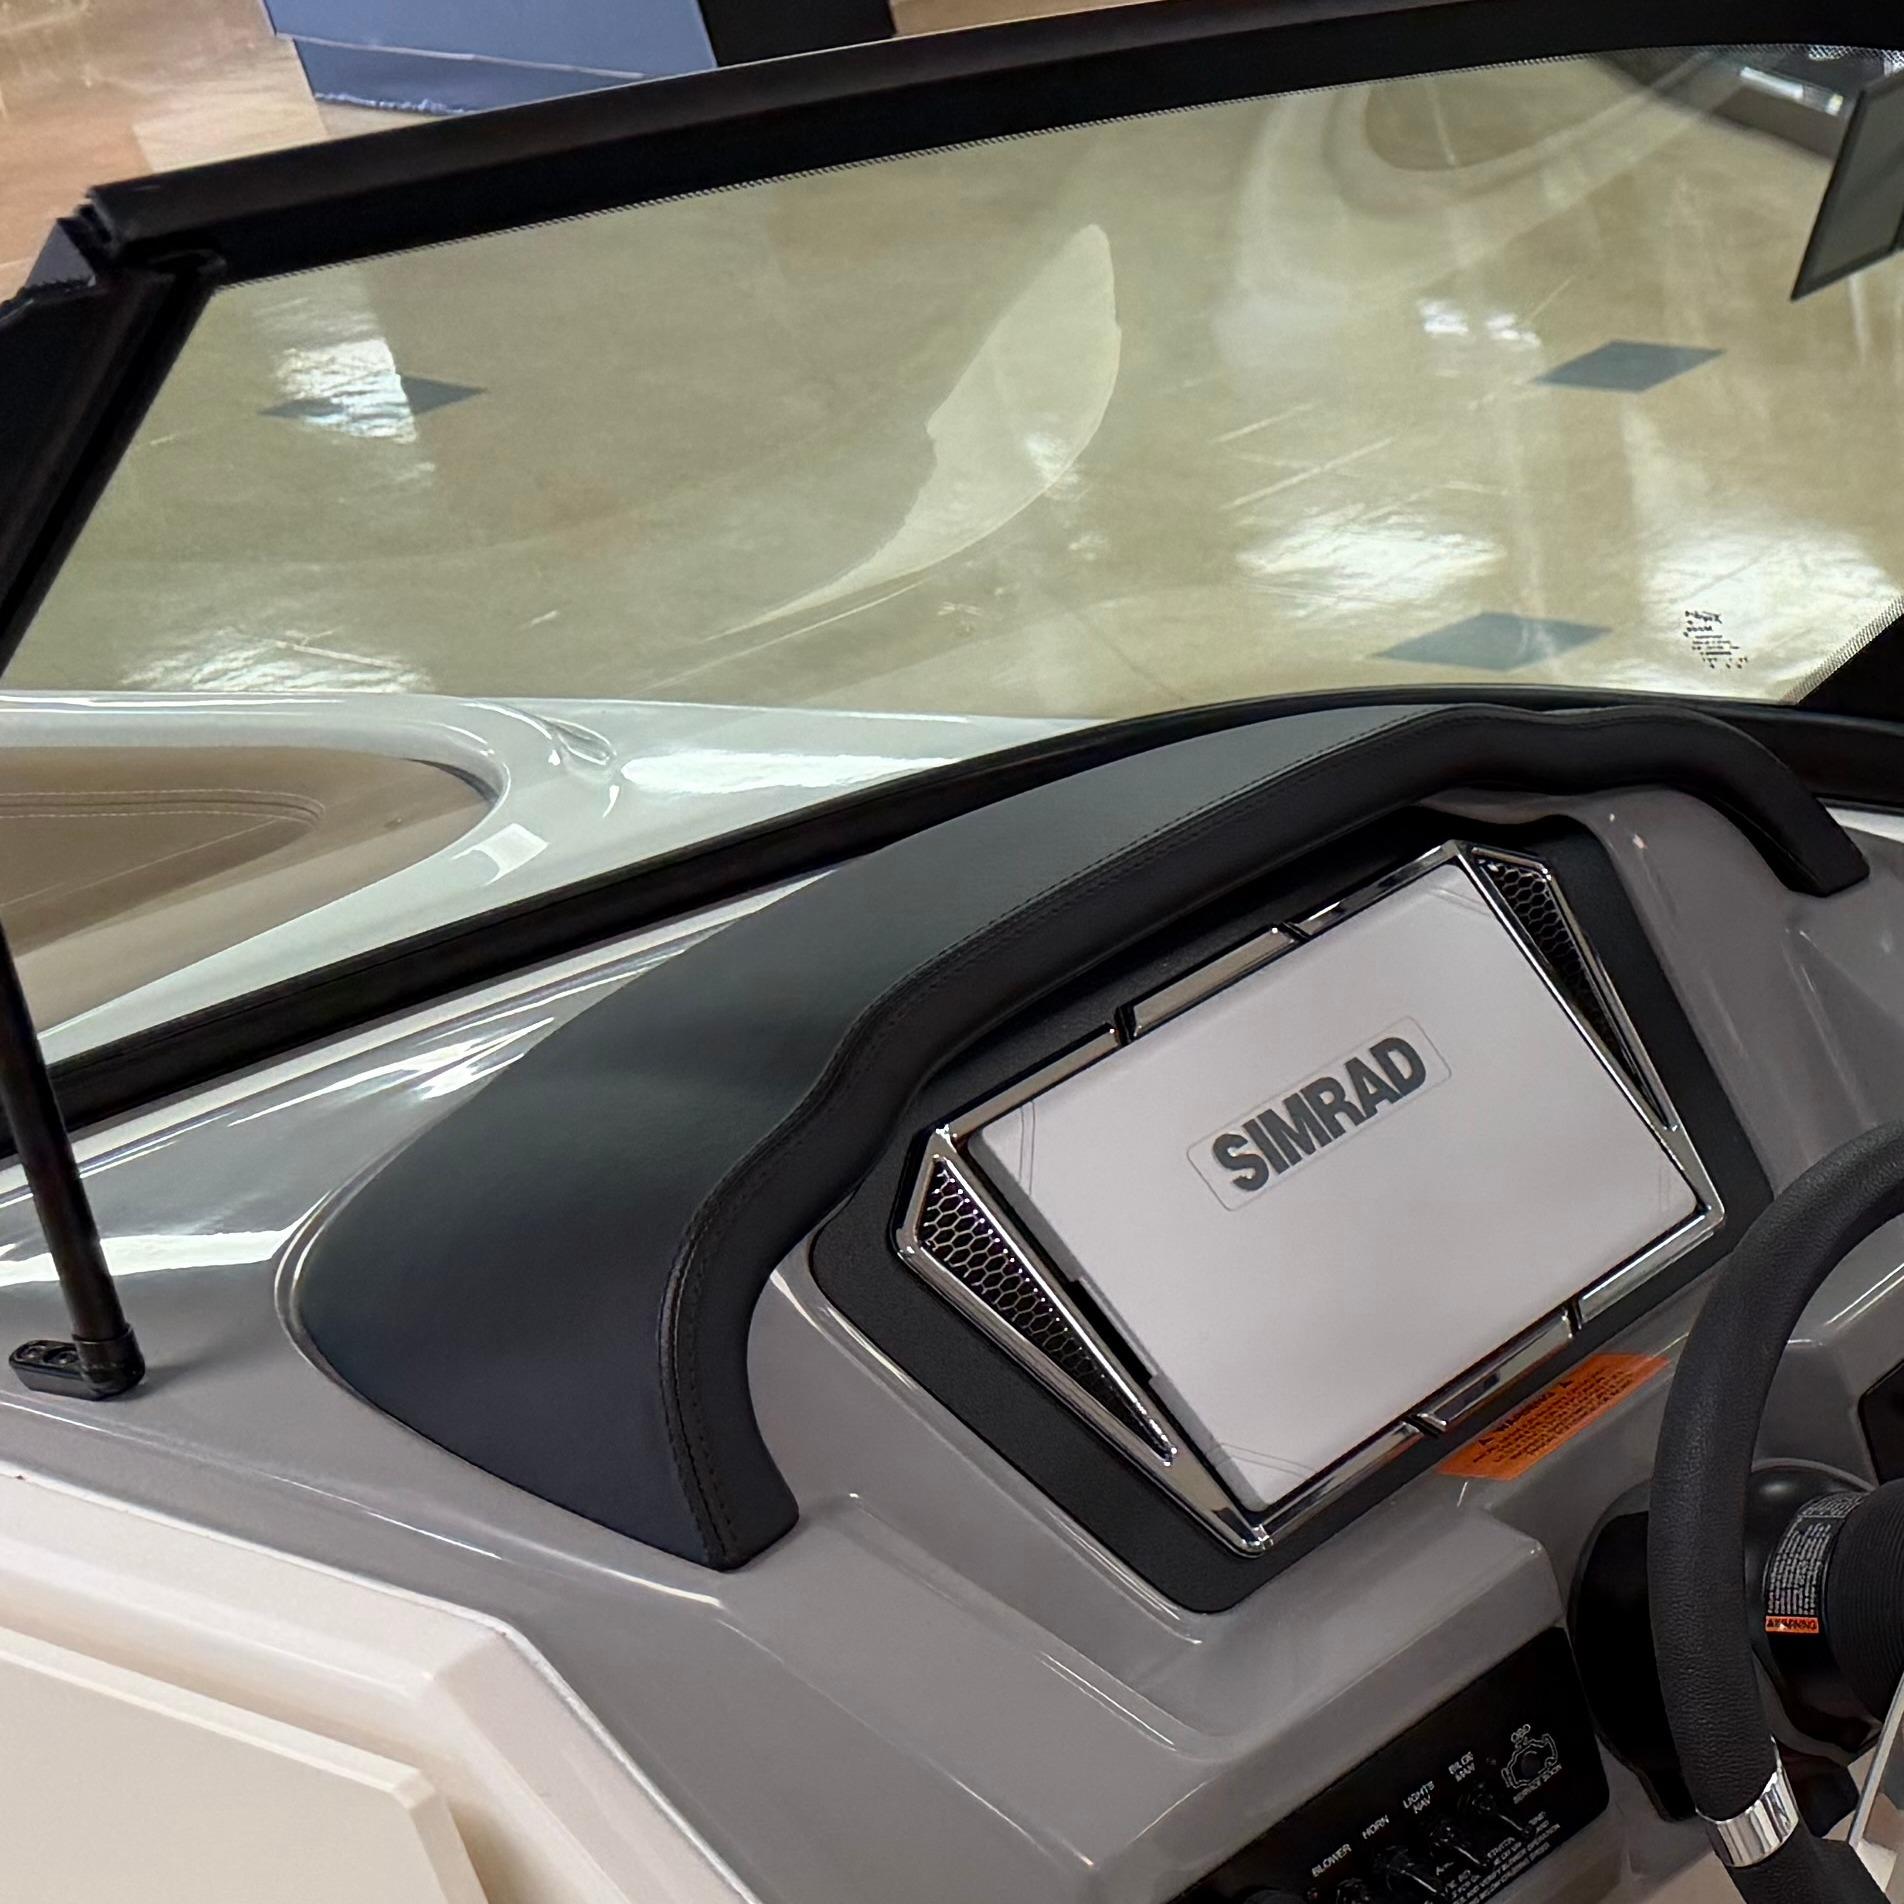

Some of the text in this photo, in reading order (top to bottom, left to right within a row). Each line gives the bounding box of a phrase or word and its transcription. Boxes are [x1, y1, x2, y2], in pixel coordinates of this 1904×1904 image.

[1212, 1036, 1427, 1192] SIMRAD
[1403, 1780, 1434, 1809] LIGHTS
[1412, 1792, 1430, 1814] NAV
[1362, 1814, 1389, 1839] HORN
[1312, 1843, 1351, 1877] BLOWER
